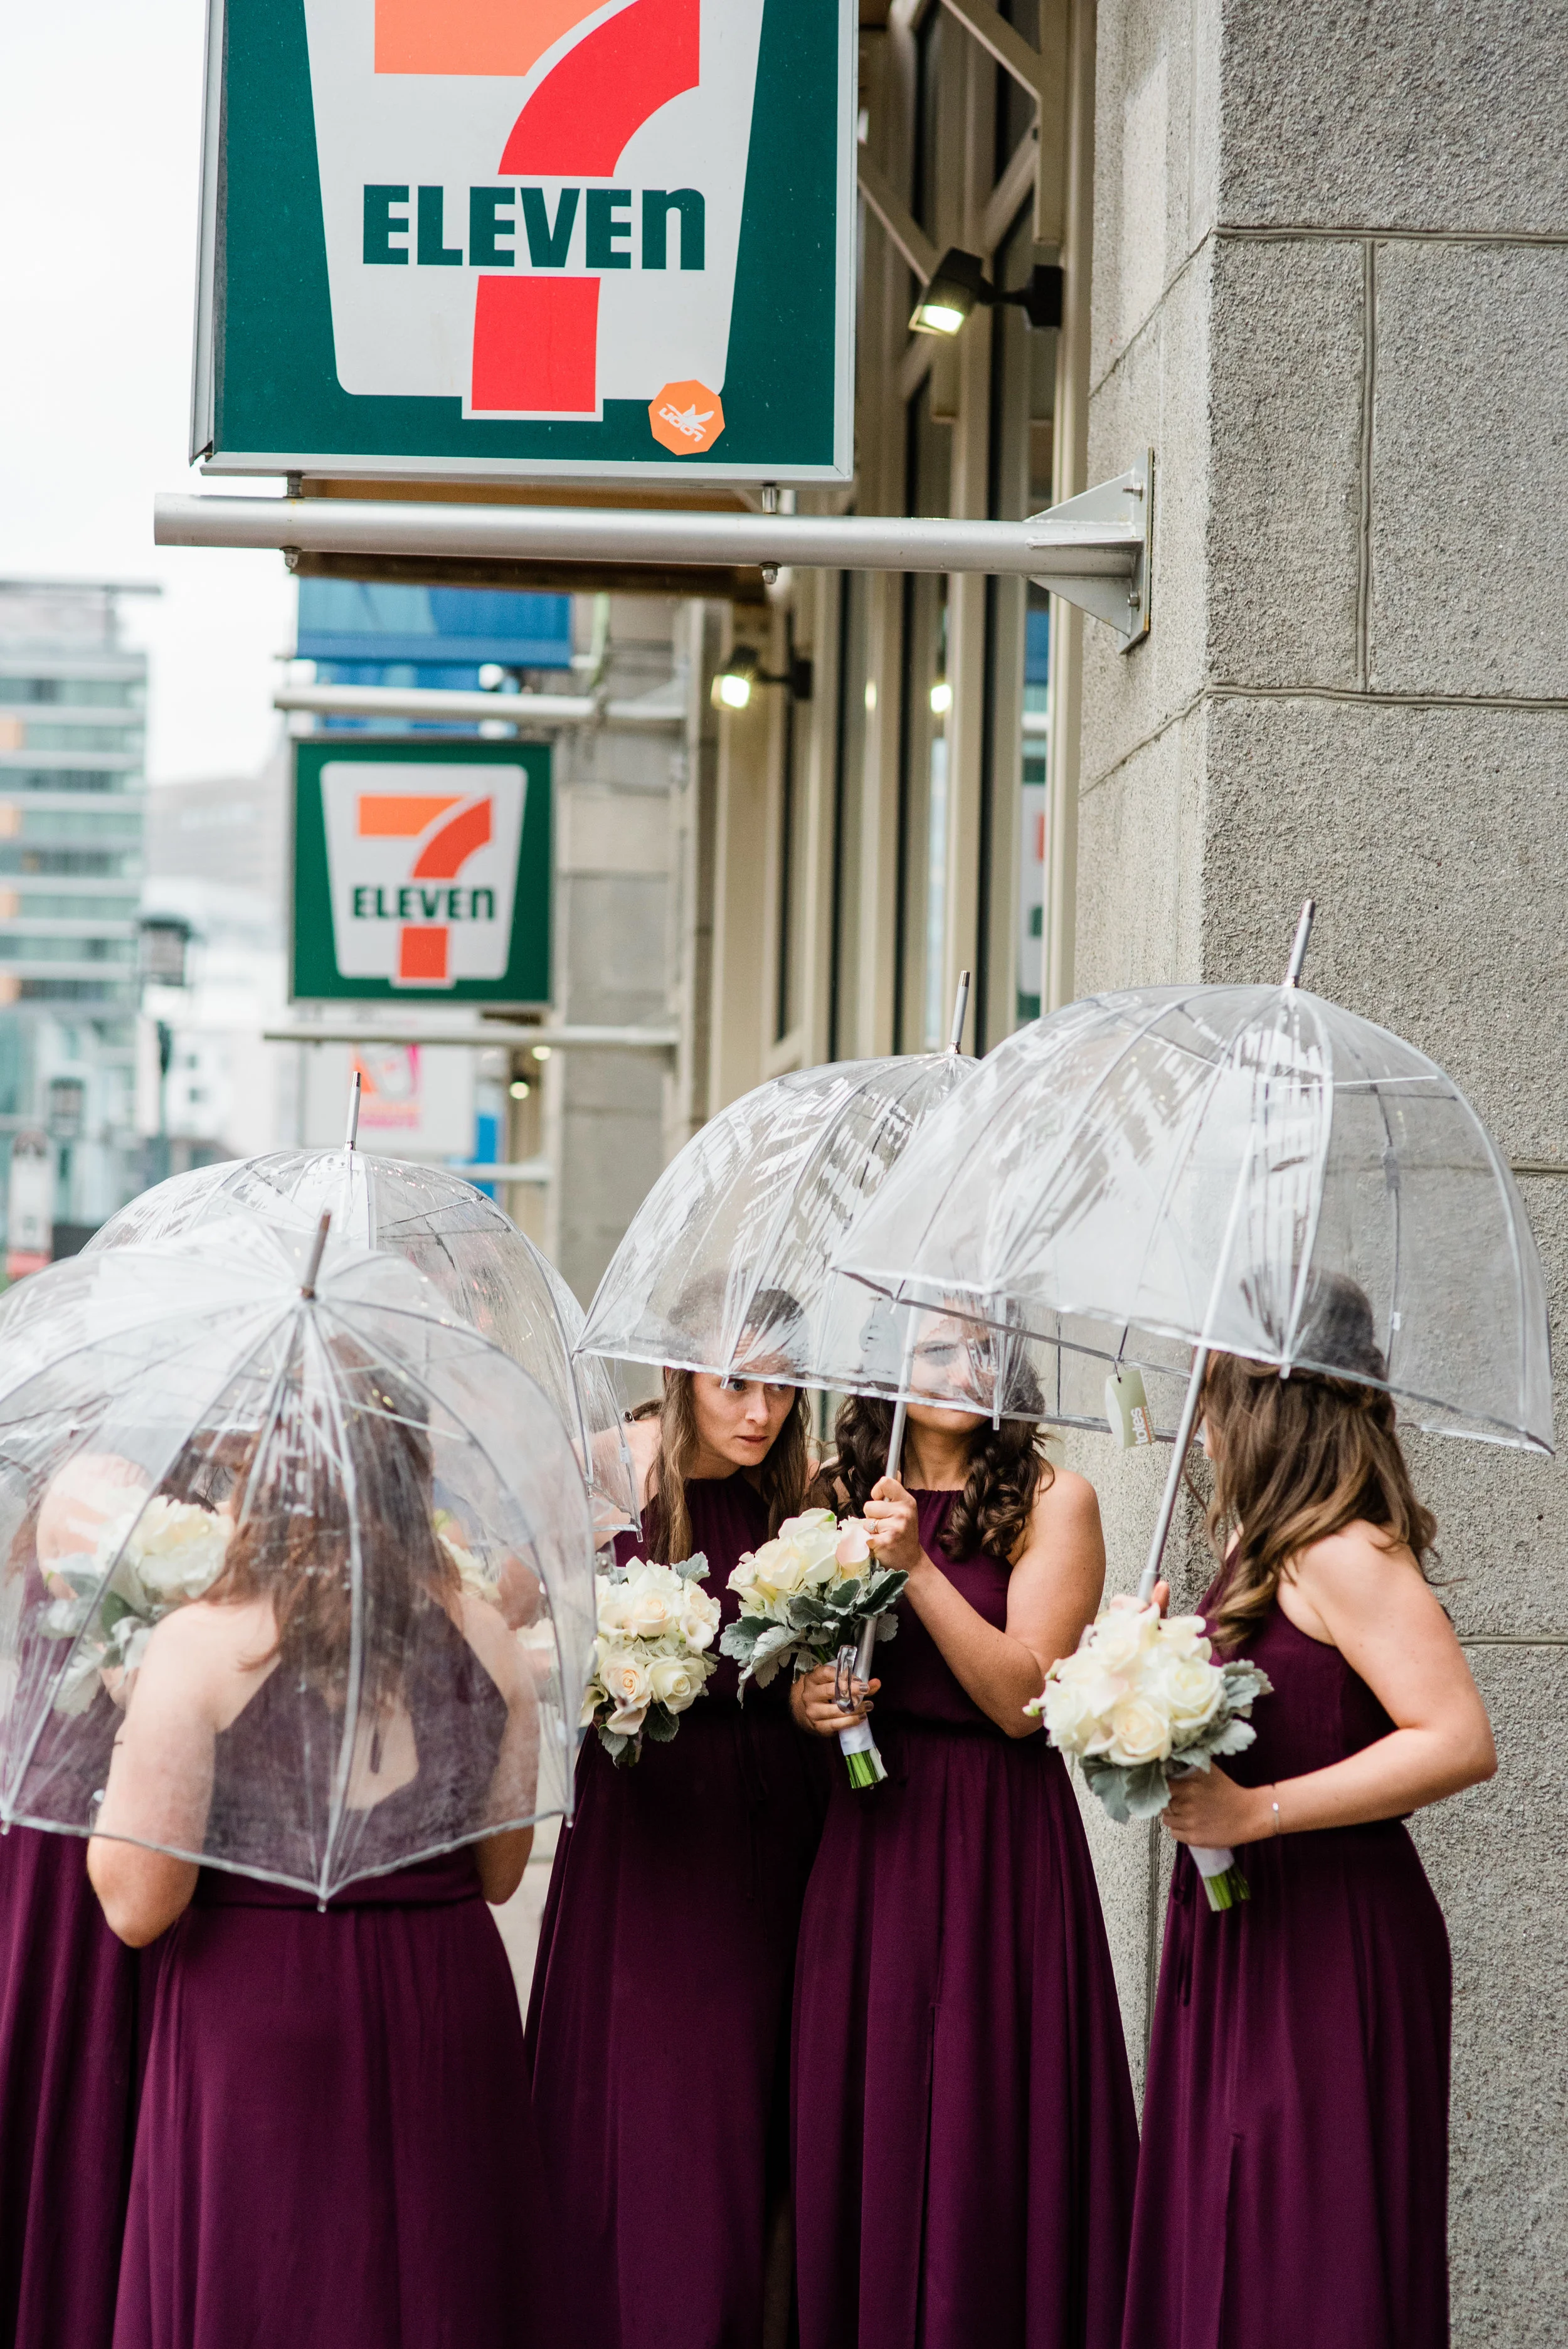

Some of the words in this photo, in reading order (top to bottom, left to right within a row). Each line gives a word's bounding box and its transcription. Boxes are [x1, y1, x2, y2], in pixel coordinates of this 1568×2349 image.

[374, 0, 699, 412] 7
[359, 796, 492, 978] 7
[1130, 1407, 1148, 1445] totes
